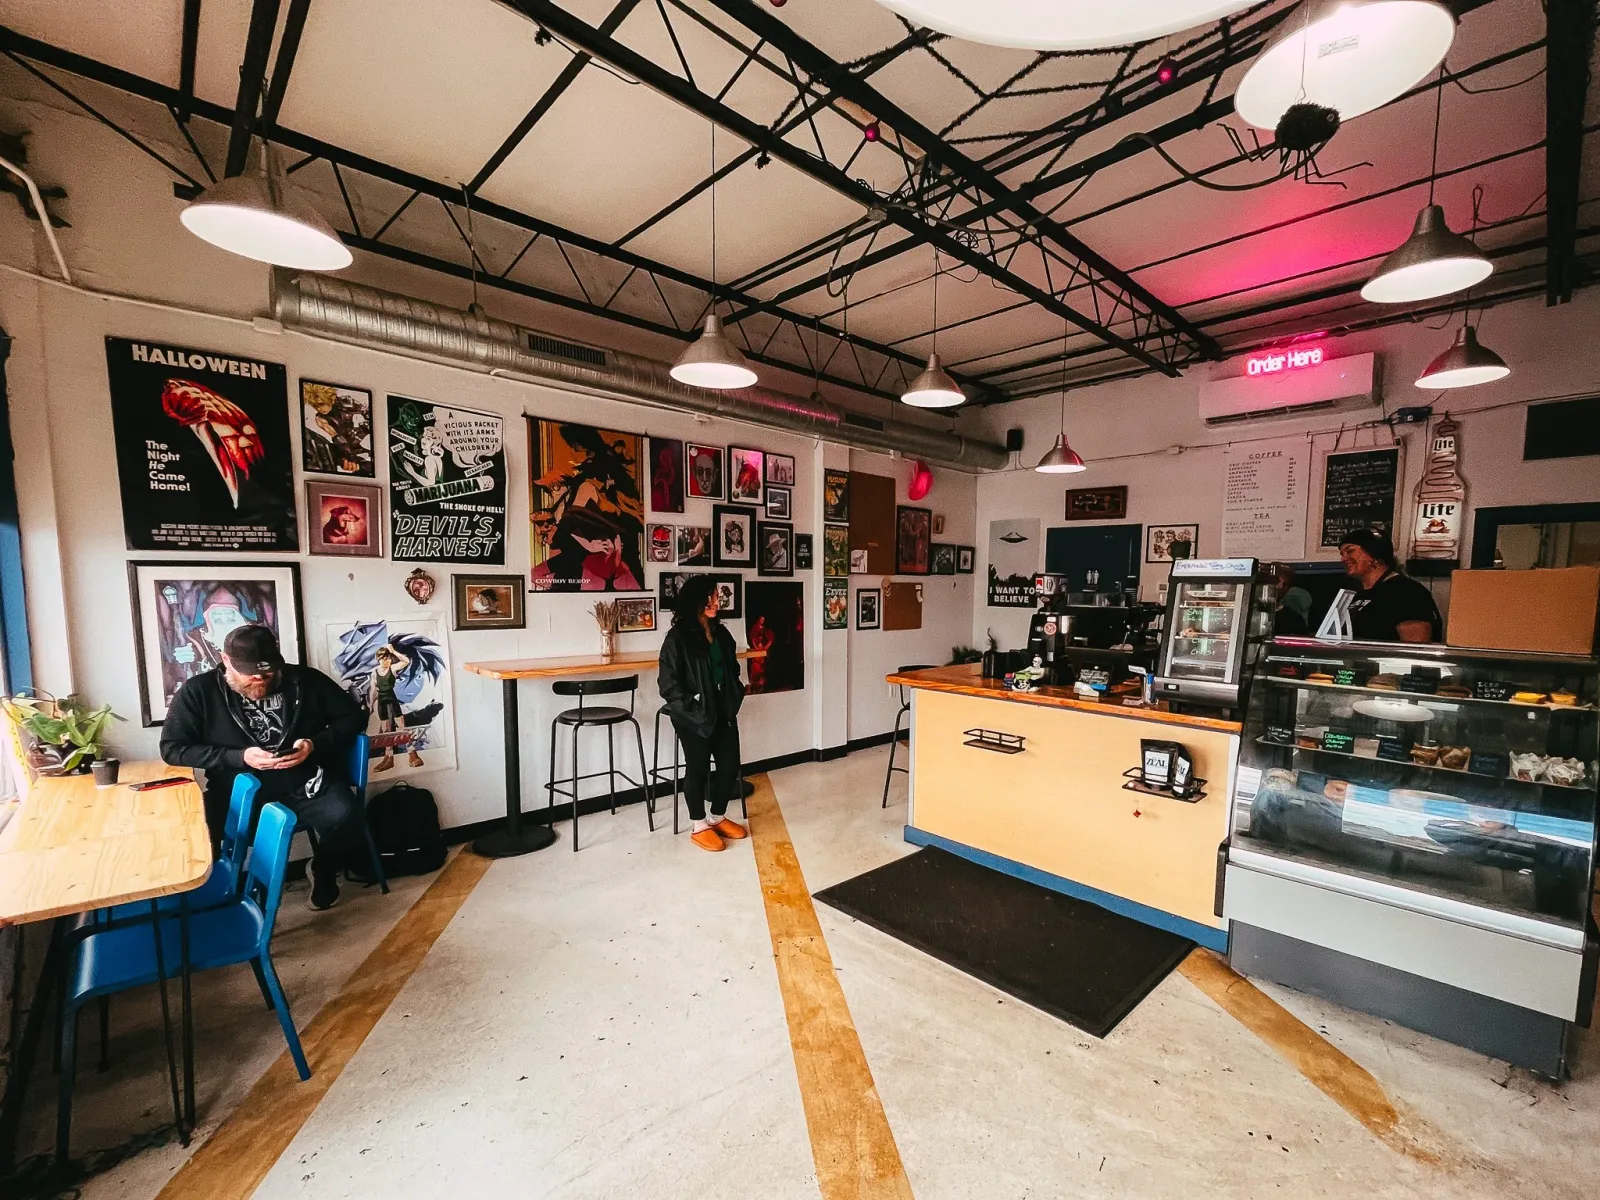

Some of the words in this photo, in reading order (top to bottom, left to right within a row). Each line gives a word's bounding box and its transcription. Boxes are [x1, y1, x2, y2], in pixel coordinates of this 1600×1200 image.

[131, 344, 267, 380] HALLOWEEN
[1247, 355, 1286, 375] Order
[1287, 349, 1322, 368] Here
[448, 411, 454, 420] A
[444, 421, 472, 429] VICIOUS
[474, 421, 499, 429] RACKET
[145, 440, 168, 451] The
[450, 437, 477, 445] AROUND
[1433, 439, 1454, 451] Lite
[147, 450, 181, 463] Night
[1248, 451, 1283, 460] COFFEE
[149, 461, 166, 470] He
[149, 471, 186, 482] Came
[150, 481, 191, 492] Home!
[413, 478, 481, 503] MARIJUANA
[439, 502, 454, 510] THE
[454, 503, 476, 511] SMOKE
[476, 504, 486, 512] OF
[486, 506, 505, 514] HELL!
[1422, 502, 1455, 519] Lite
[989, 586, 993, 594] I
[995, 586, 1020, 594] WANT
[1023, 587, 1035, 595] TO
[993, 595, 1030, 603] BELIEVE
